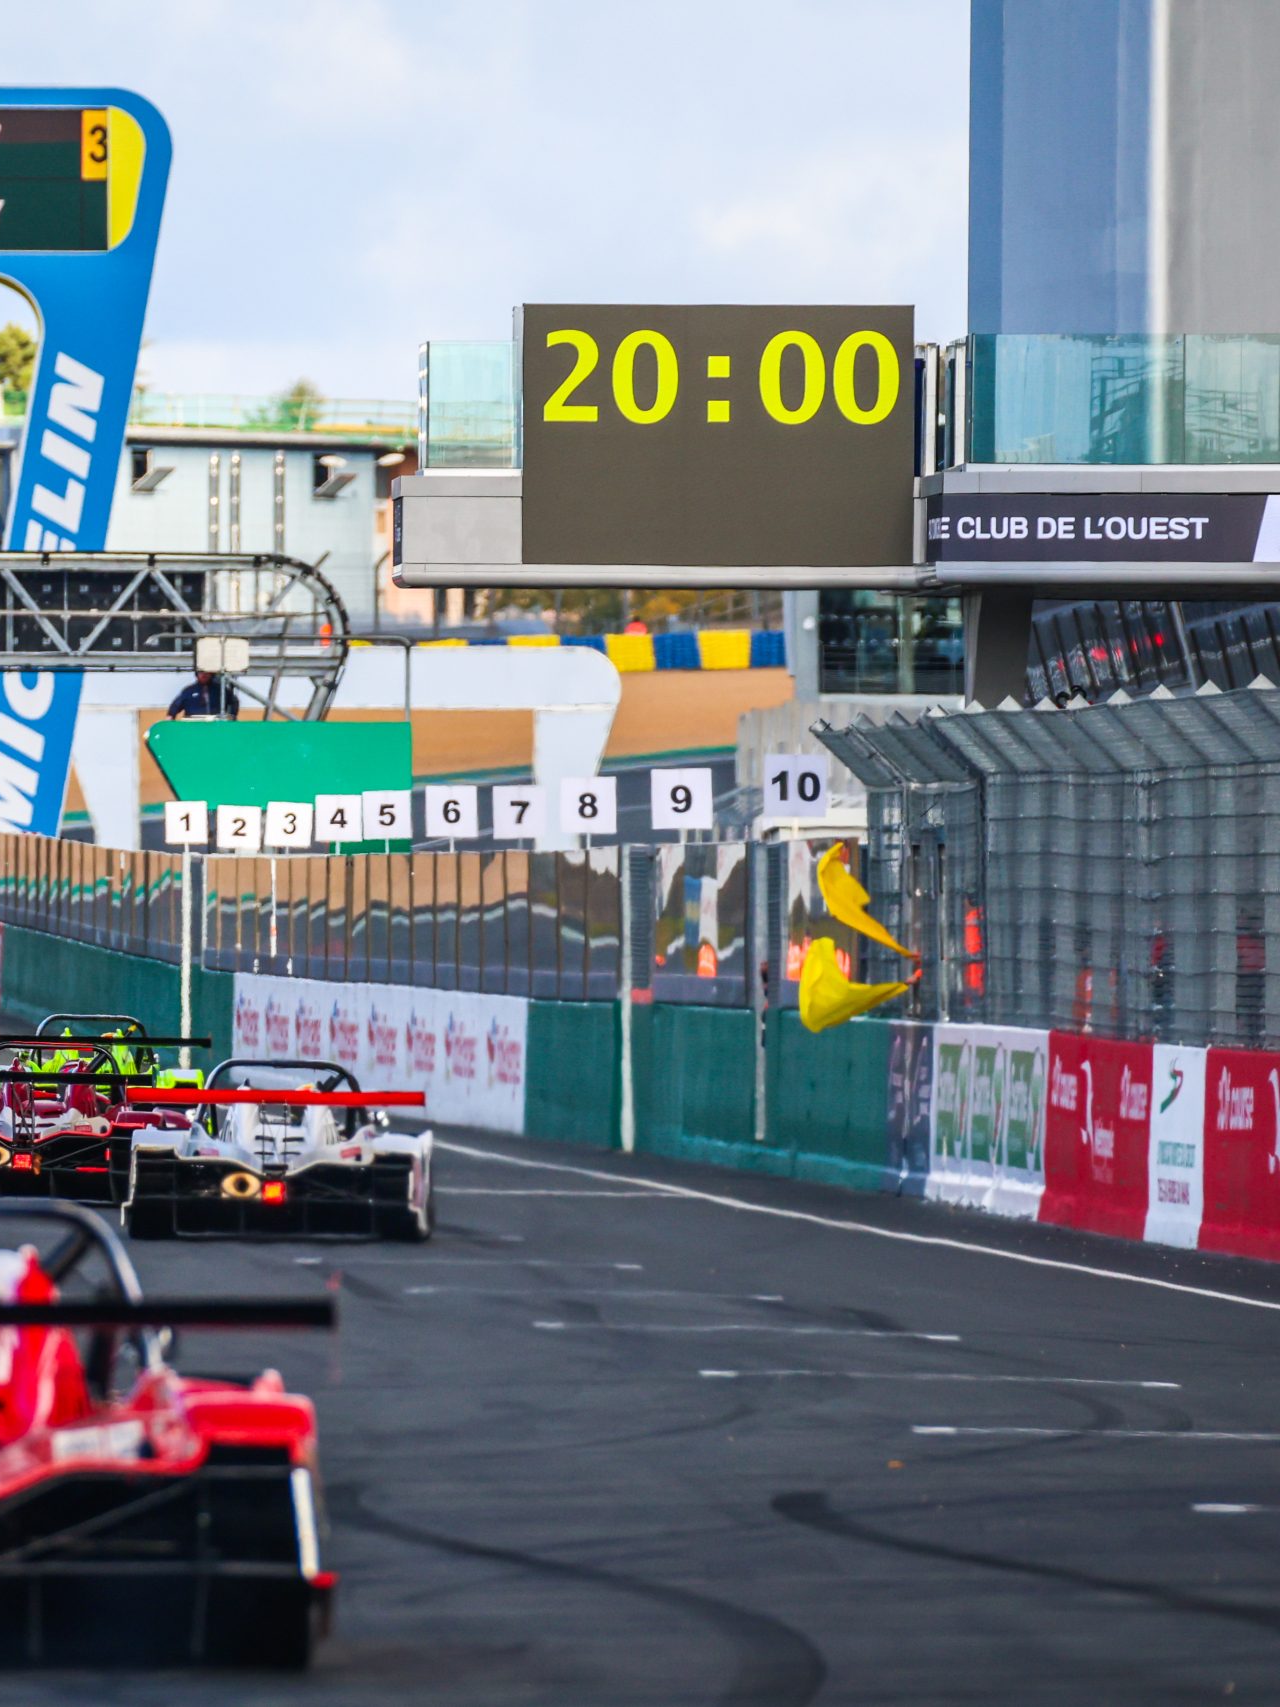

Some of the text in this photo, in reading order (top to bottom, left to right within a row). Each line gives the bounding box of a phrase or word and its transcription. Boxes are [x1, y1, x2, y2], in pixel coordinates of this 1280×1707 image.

[88, 124, 108, 164] 3
[542, 329, 901, 426] 20:00
[956, 516, 1029, 540] CLUB
[1036, 516, 1077, 540] DE
[1083, 516, 1210, 541] L'OUEST
[771, 770, 821, 803] 10
[442, 799, 461, 824] 6
[510, 800, 530, 824] 7
[578, 792, 598, 819] 8
[669, 785, 692, 814] 9
[179, 813, 191, 832] 1
[232, 818, 247, 837] 2
[282, 812, 298, 835] 3
[329, 808, 348, 829] 4
[378, 804, 397, 827] 5
